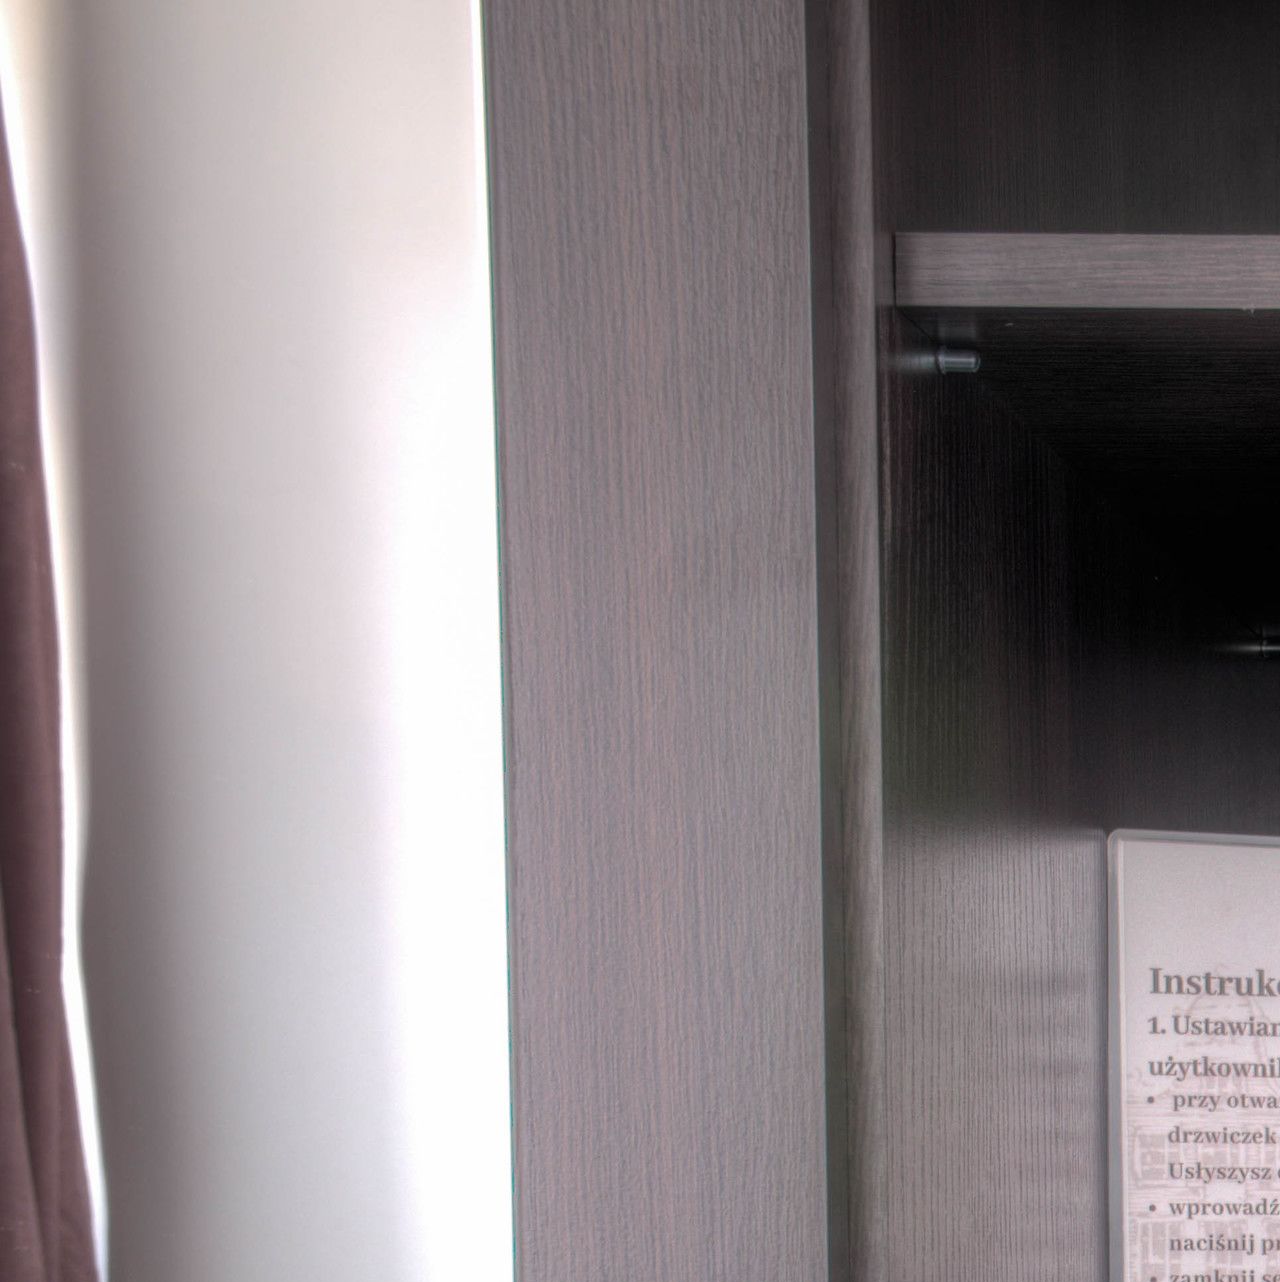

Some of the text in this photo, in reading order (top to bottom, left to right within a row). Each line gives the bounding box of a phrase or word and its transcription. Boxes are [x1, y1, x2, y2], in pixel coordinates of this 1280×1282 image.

[1147, 1017, 1167, 1035] 1.
[1173, 1093, 1221, 1111] przy
[1168, 1126, 1276, 1145] drzwiczek
[1168, 1162, 1271, 1183] Usłyszysz
[1169, 1199, 1279, 1218] wprowadź
[1169, 1234, 1254, 1254] naciśnij
